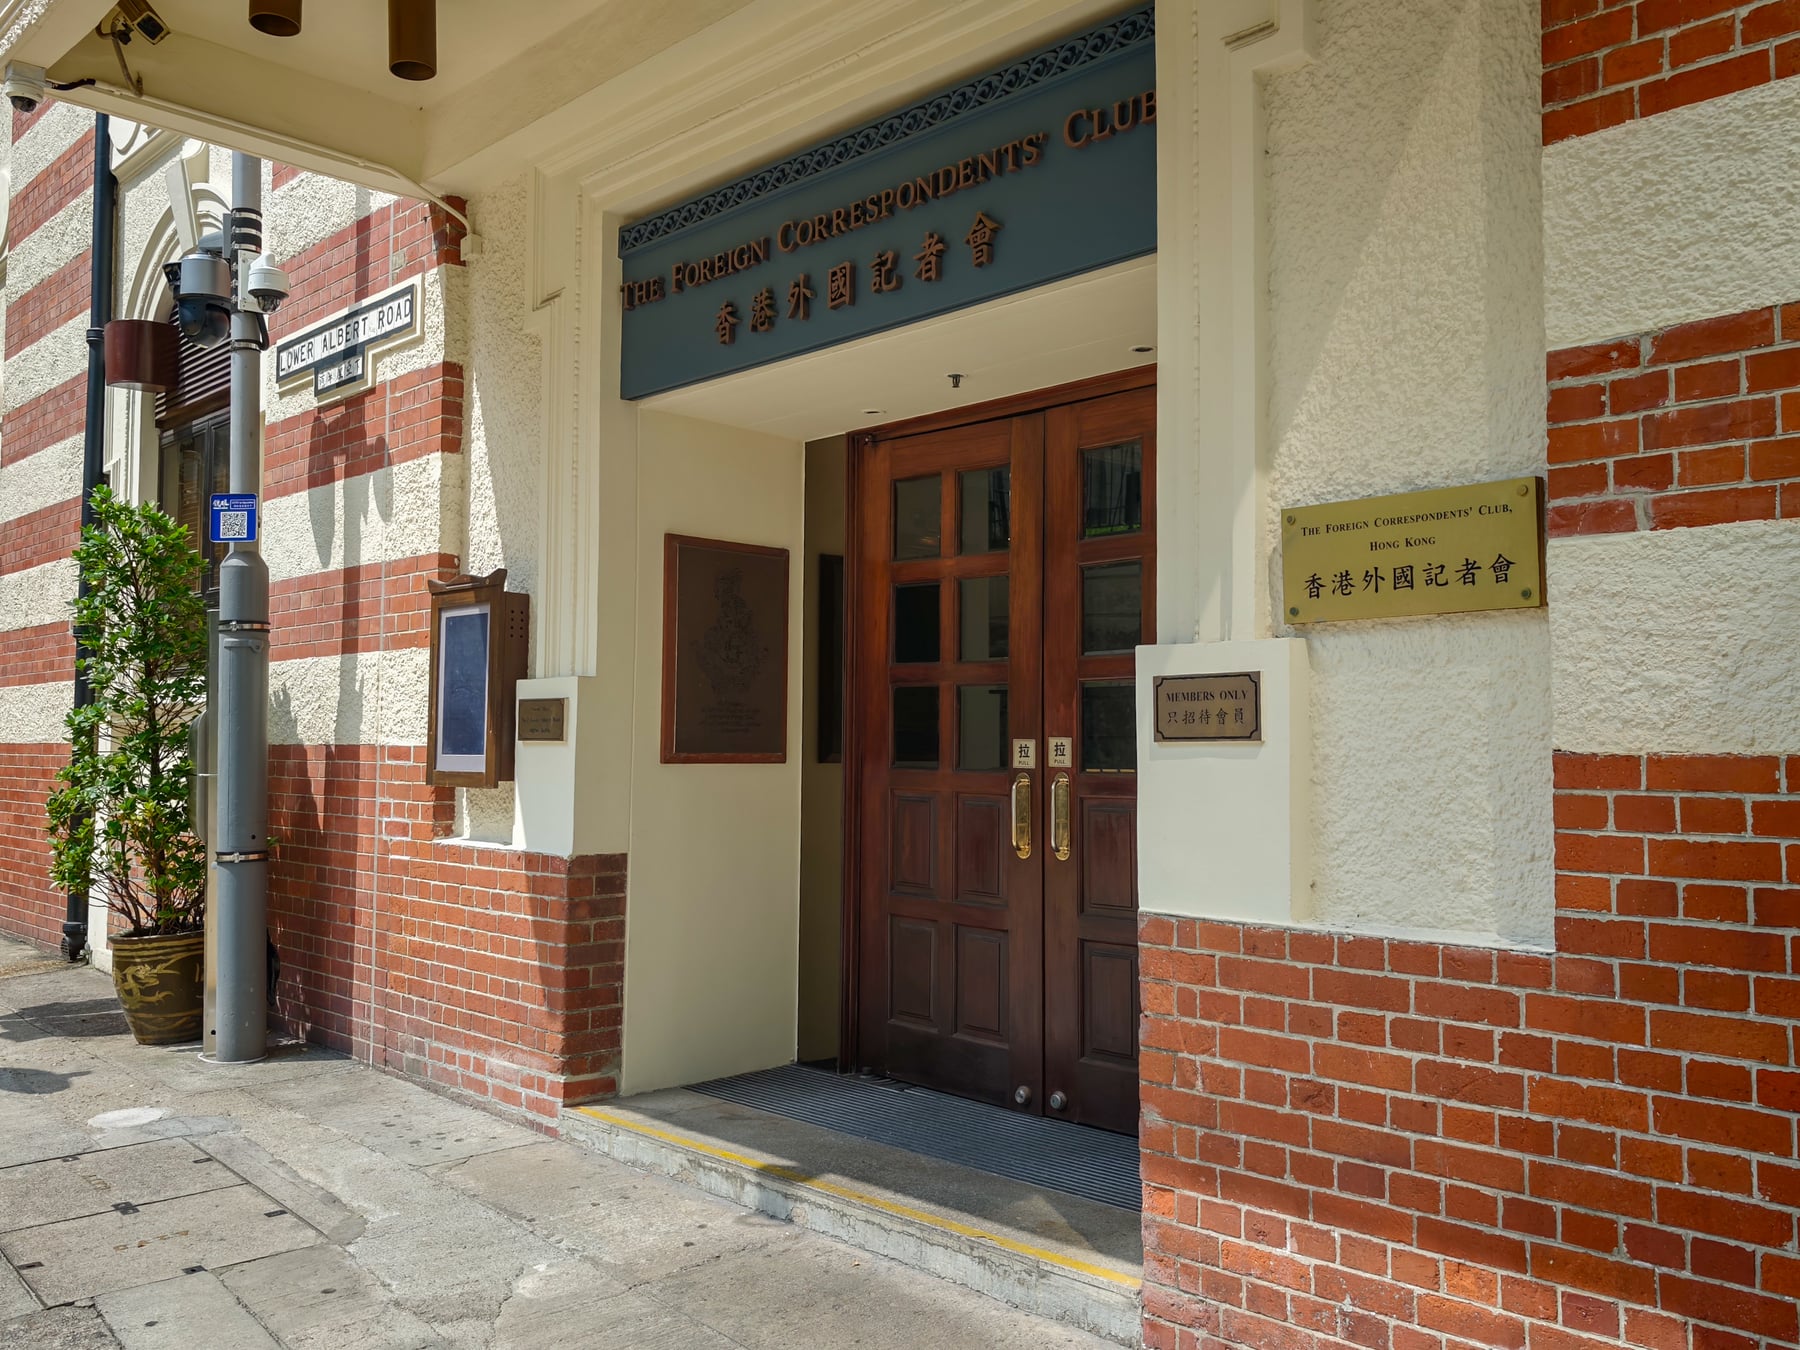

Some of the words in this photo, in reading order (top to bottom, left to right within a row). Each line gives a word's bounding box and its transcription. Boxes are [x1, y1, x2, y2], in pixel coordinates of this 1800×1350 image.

[620, 275, 666, 311] THE
[671, 237, 770, 294] FOREIGN
[777, 131, 1049, 253] CORRESPONDENTS'
[1063, 90, 1157, 149] CLUB
[714, 211, 1002, 345] 香港外國記者會
[280, 341, 314, 372] LOWER
[322, 317, 368, 353] ALBERT
[378, 298, 412, 330] ROAD
[1301, 526, 1321, 537] THE
[1325, 519, 1369, 534] FOREIGN
[1374, 506, 1473, 528] CORRESPONDENTS'
[1478, 503, 1513, 516] CLUB,
[1370, 541, 1400, 551] HONG
[1405, 536, 1436, 548] KONG
[1304, 553, 1516, 600] 香港外國記者會
[1166, 691, 1215, 702] MEMBERS
[1219, 690, 1249, 700] ONLY
[1167, 707, 1245, 725] 只招待會員
[1018, 744, 1030, 758] 拉
[1054, 742, 1066, 757] 拉
